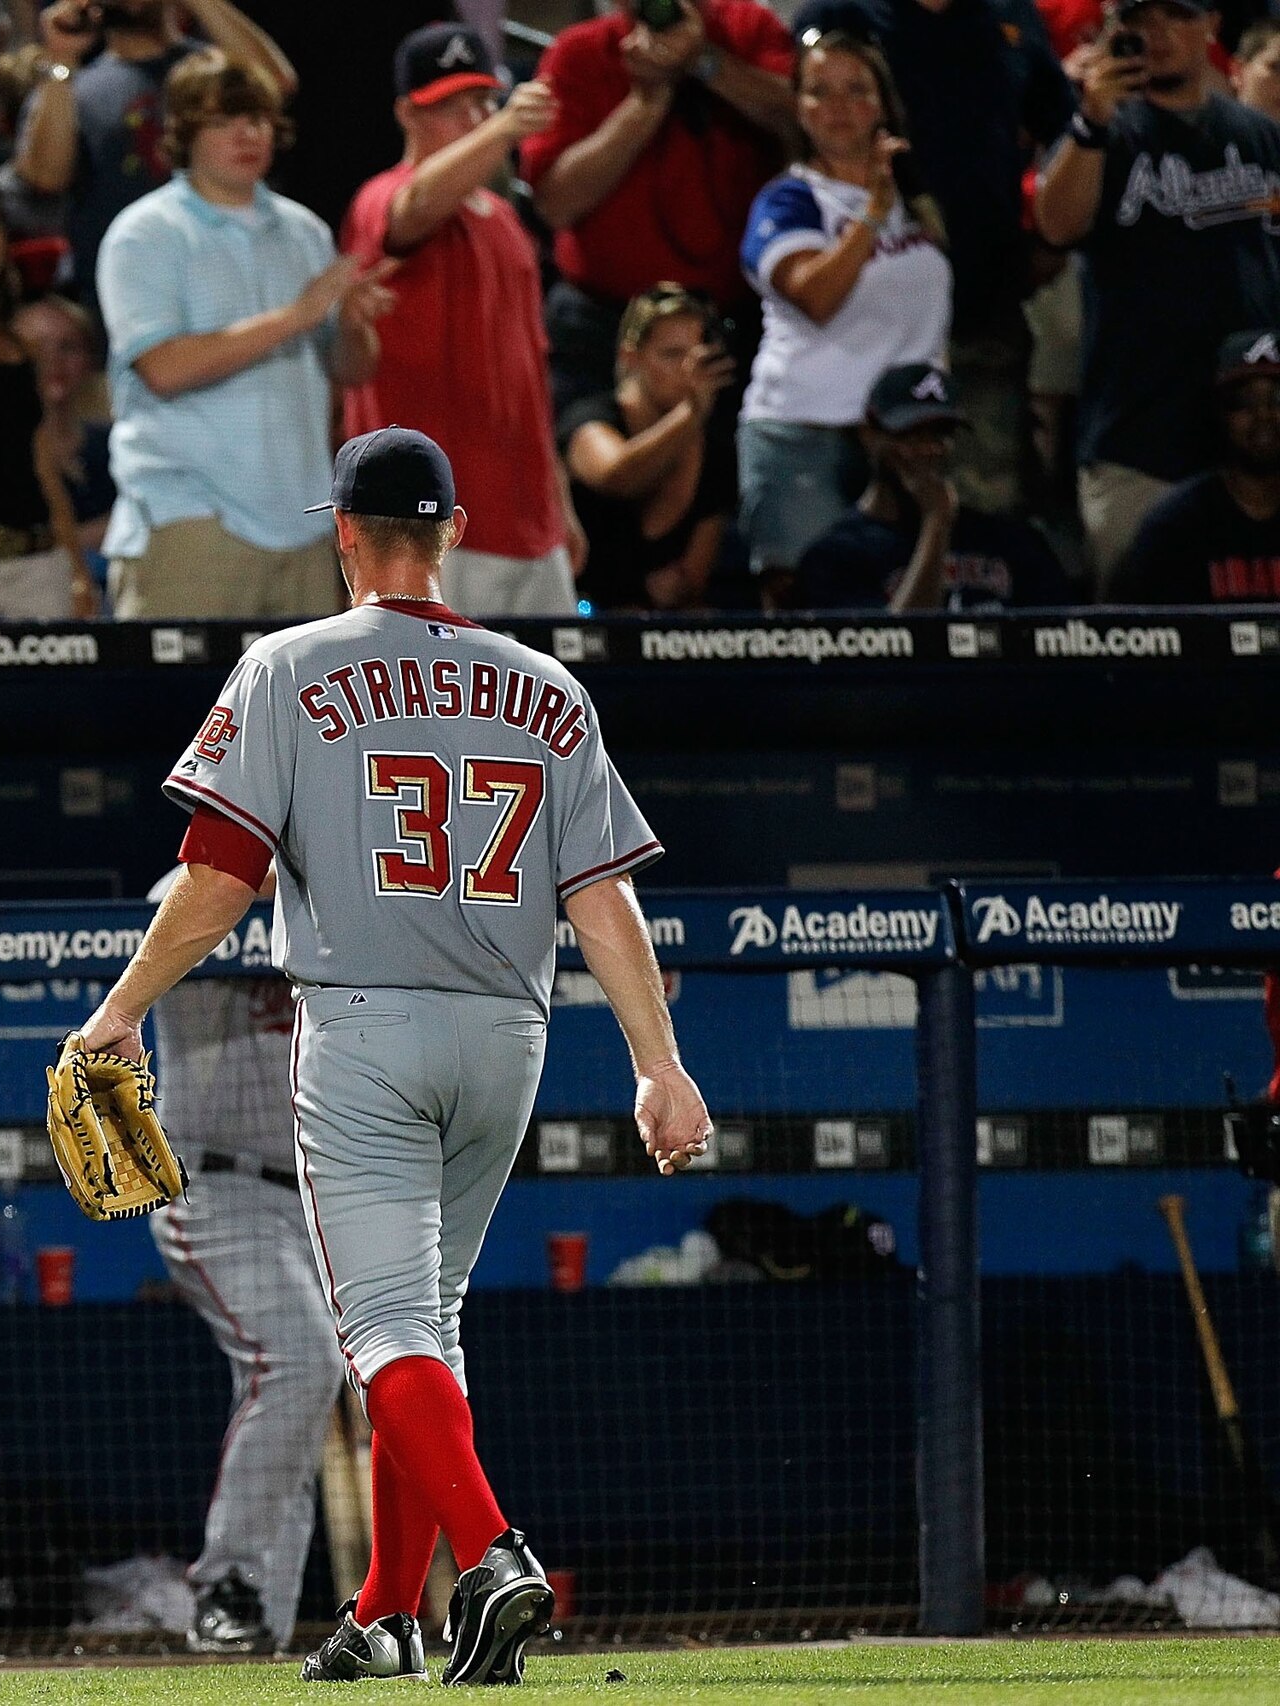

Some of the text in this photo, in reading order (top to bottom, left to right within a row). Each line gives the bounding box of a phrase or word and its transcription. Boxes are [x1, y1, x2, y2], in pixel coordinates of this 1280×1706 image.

[641, 627, 914, 664] neweracap.com
[1034, 619, 1182, 657] mlb.com
[298, 658, 588, 760] STRASBURG
[363, 751, 546, 906] 37
[781, 903, 939, 947] Academy
[1025, 895, 1180, 939] Academy
